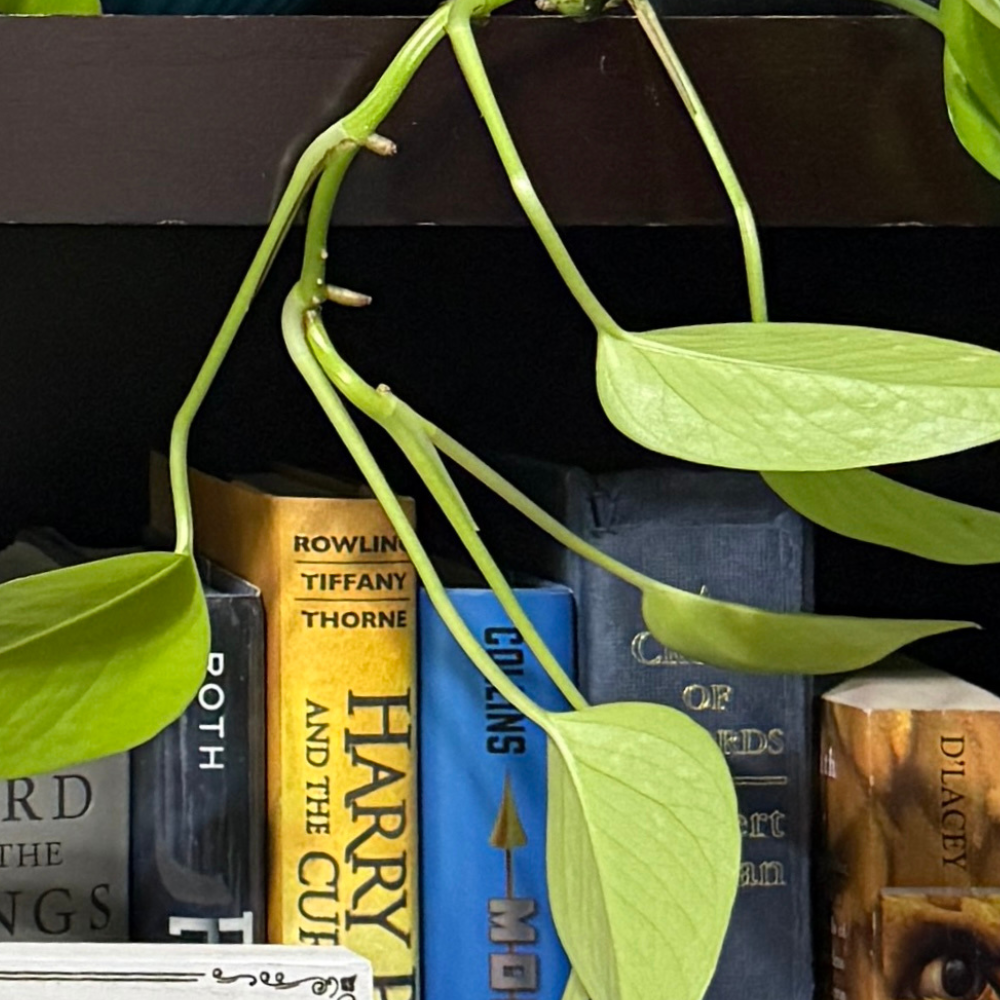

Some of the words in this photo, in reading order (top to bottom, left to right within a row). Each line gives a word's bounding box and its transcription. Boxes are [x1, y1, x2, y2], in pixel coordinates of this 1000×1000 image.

[301, 573, 406, 591] TIFFANY
[301, 610, 407, 628] THORNE
[199, 653, 225, 769] ROTH
[682, 684, 732, 710] OF
[306, 698, 330, 768] AND
[716, 728, 784, 755] RDS
[306, 775, 330, 835] THE
[345, 688, 411, 949] HARRY
[940, 736, 967, 872] D'LACEY
